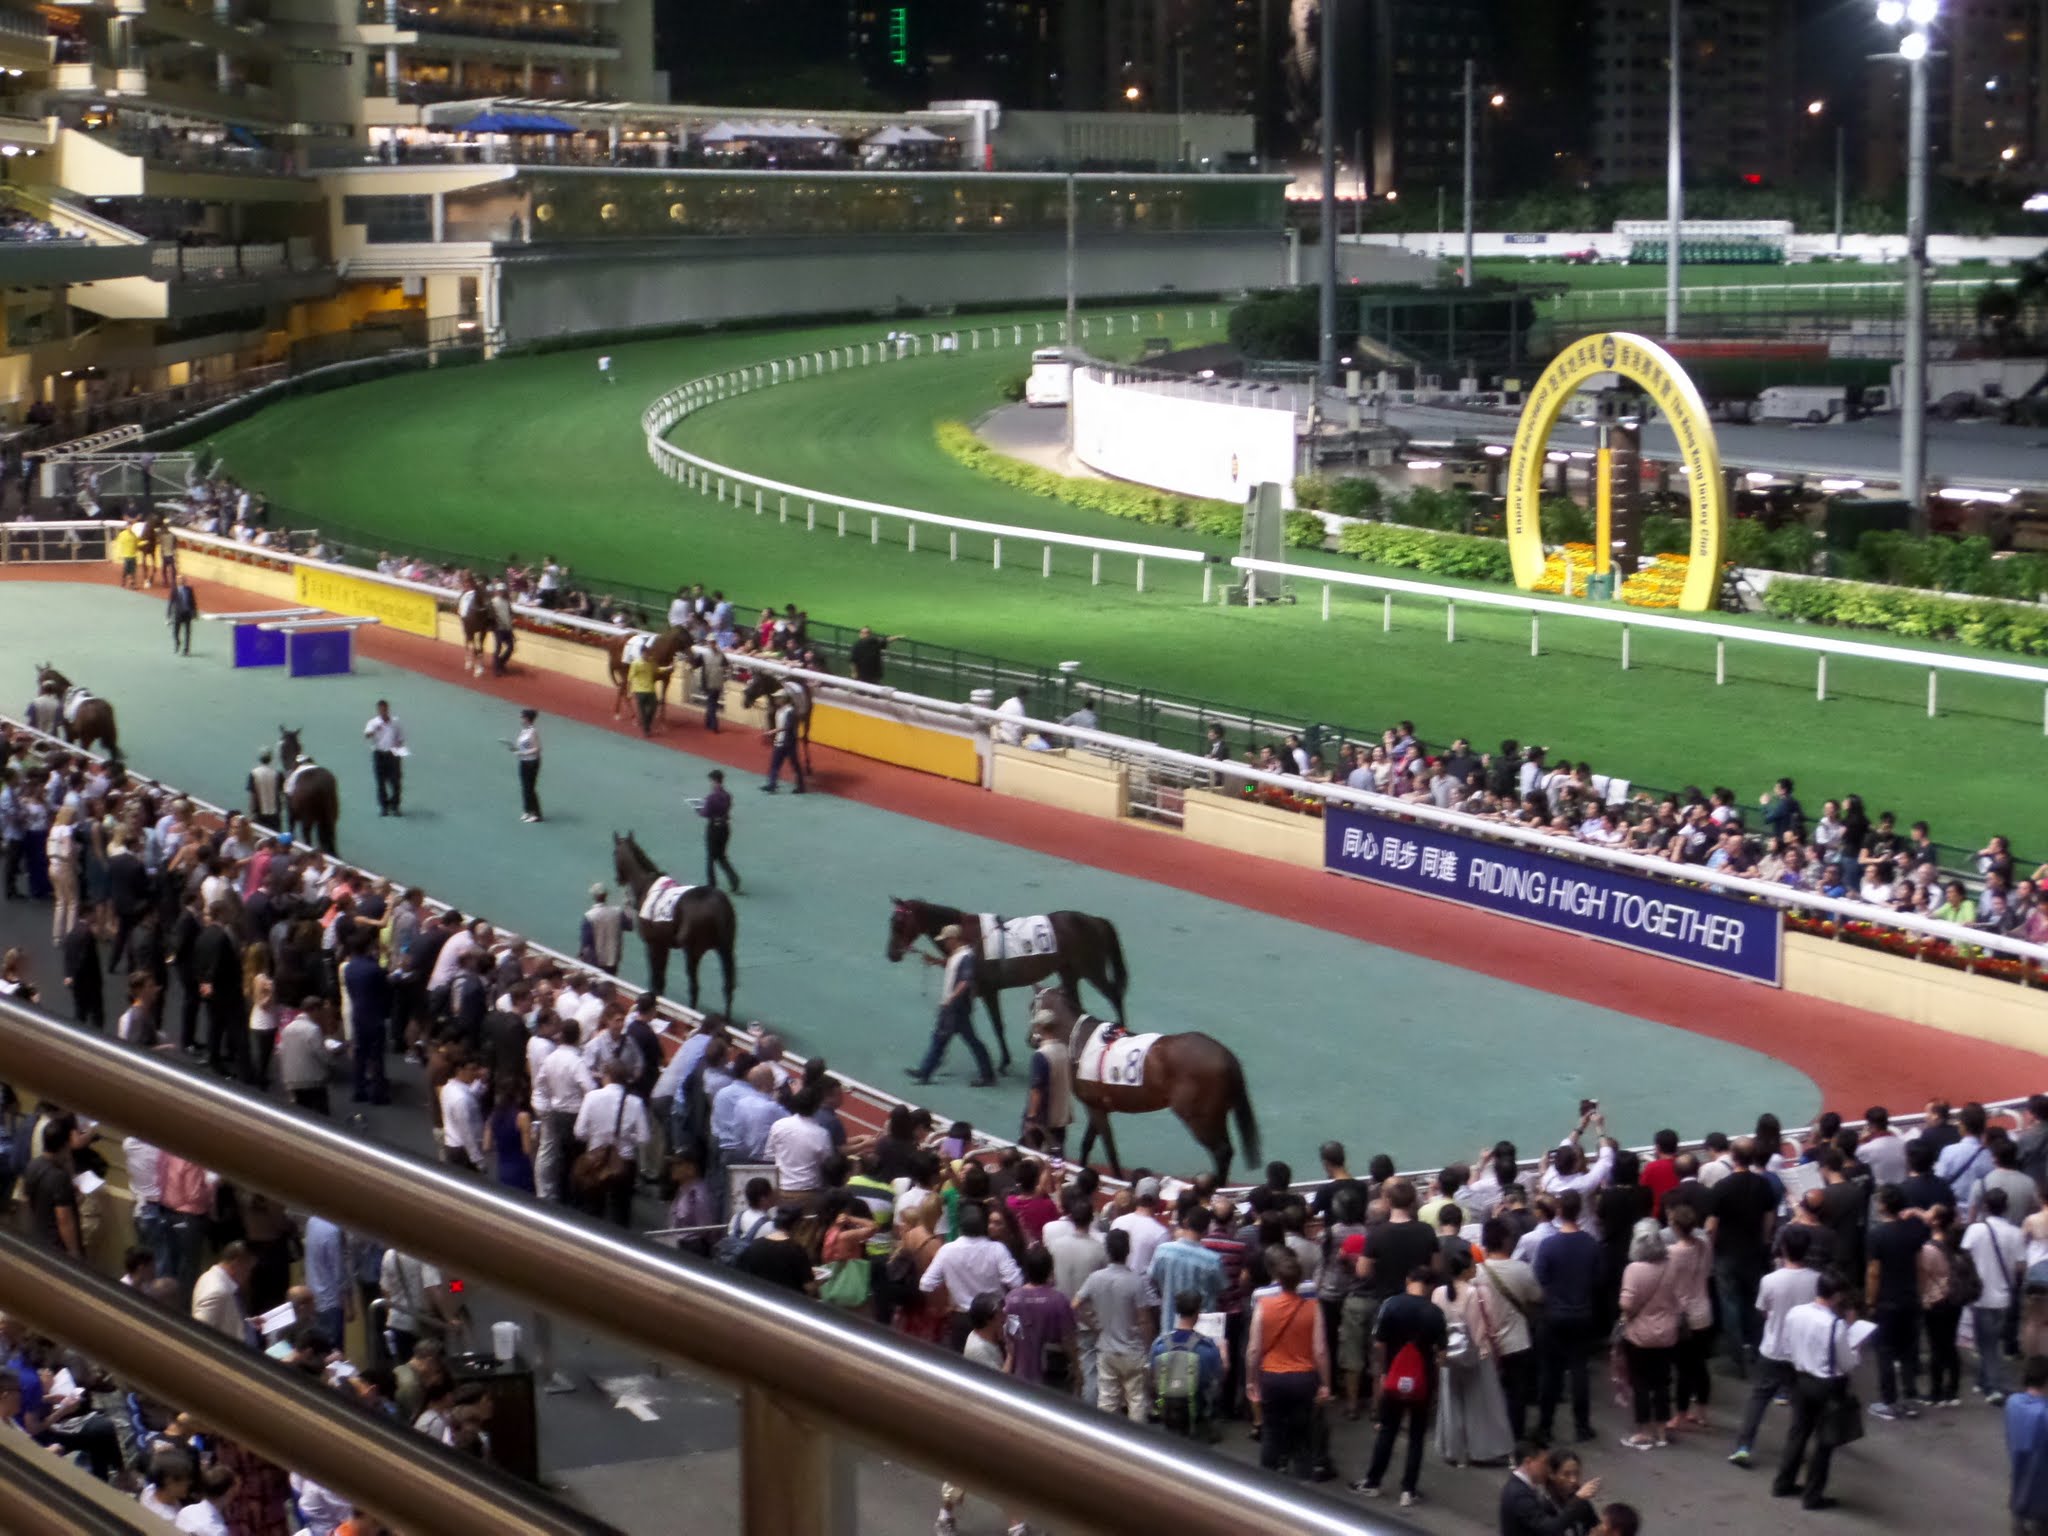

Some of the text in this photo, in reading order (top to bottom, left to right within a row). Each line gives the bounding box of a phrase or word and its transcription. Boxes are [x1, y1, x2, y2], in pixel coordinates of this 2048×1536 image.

[1691, 448, 1704, 480] Kong
[1698, 482, 1709, 525] Jockey
[1700, 528, 1710, 557] Club
[1342, 827, 1459, 882] 同心 同步 同進
[1468, 858, 1745, 954] RIDING HIGH TOGETHER
